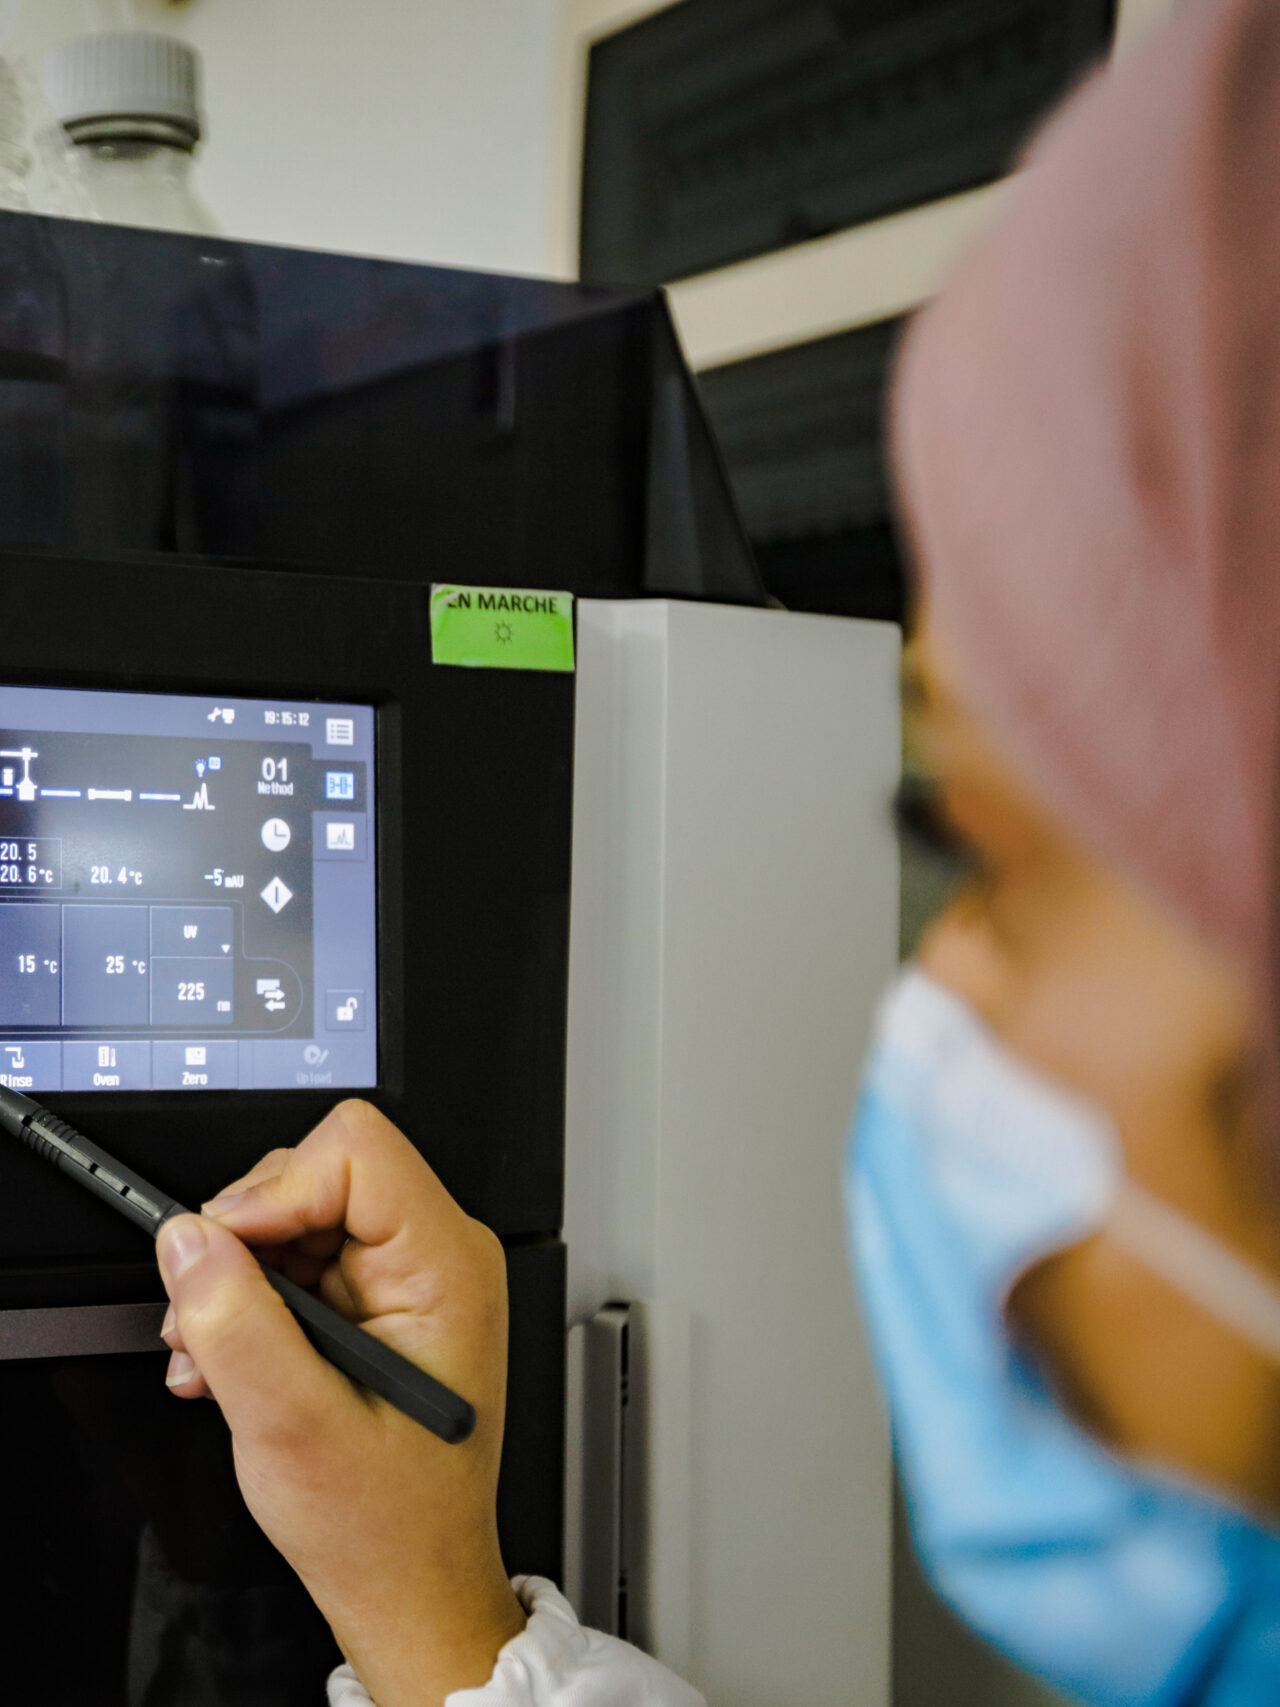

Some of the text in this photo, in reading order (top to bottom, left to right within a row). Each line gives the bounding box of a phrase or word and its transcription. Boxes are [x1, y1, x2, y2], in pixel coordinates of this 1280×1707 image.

[478, 593, 558, 614] MARCHE
[264, 710, 310, 726] 19:15:12
[262, 757, 288, 782] 01
[257, 781, 294, 796] Method
[184, 926, 197, 939] UV
[18, 955, 36, 973] 15
[106, 956, 124, 974] 25
[178, 983, 205, 1000] 225
[0, 1074, 32, 1087] Rinse
[93, 1073, 120, 1086] Oven
[182, 1072, 208, 1085] Zero
